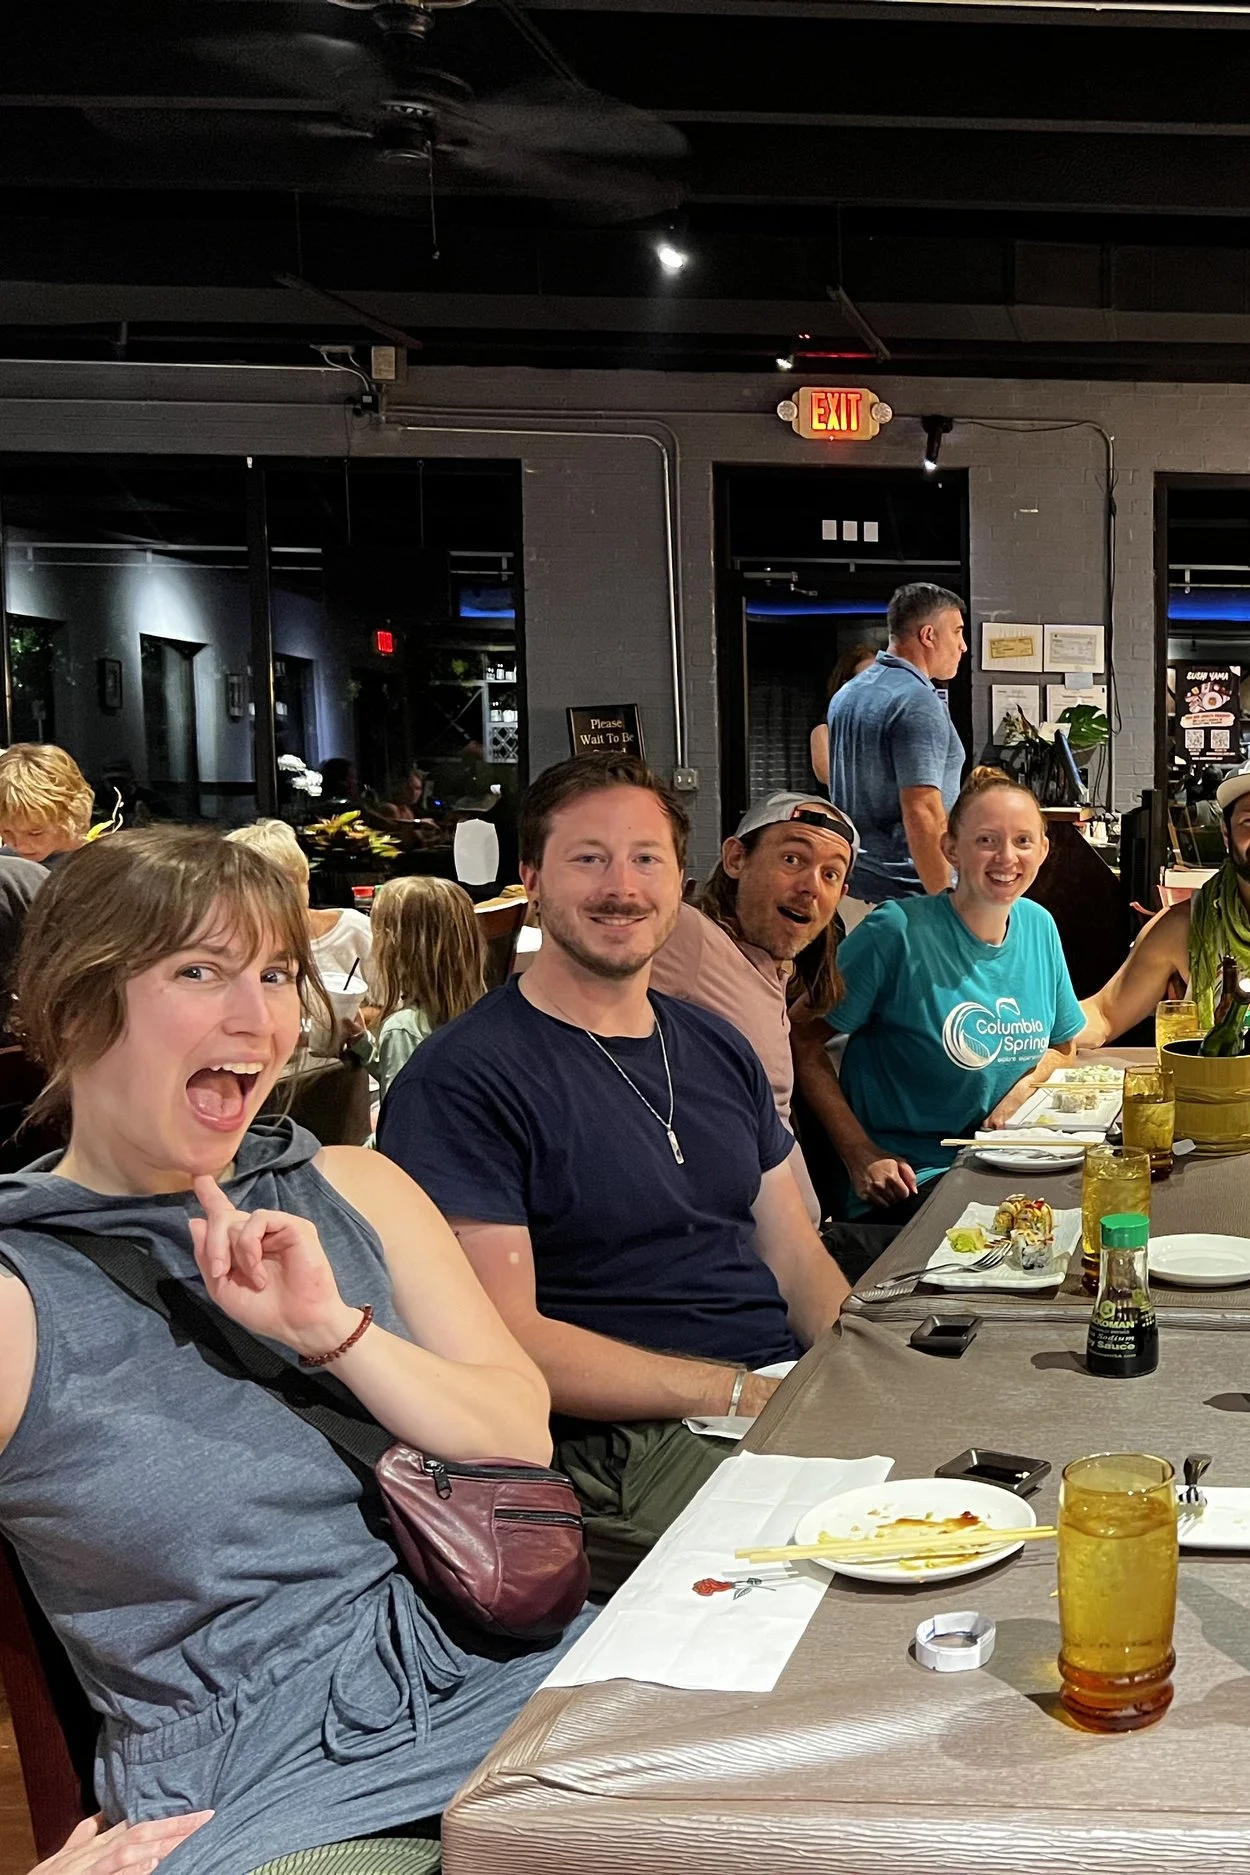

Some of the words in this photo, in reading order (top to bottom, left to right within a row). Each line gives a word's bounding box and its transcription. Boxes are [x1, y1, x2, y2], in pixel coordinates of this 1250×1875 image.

[811, 392, 861, 431] EXIT
[1186, 671, 1208, 681] SUSHI
[1208, 672, 1229, 681] YAMA
[590, 719, 622, 729] Please
[580, 733, 605, 746] Wait
[606, 732, 619, 744] To
[621, 732, 634, 743] Be
[976, 1018, 1043, 1034] Columbia
[1097, 1340, 1136, 1350] Sauce
